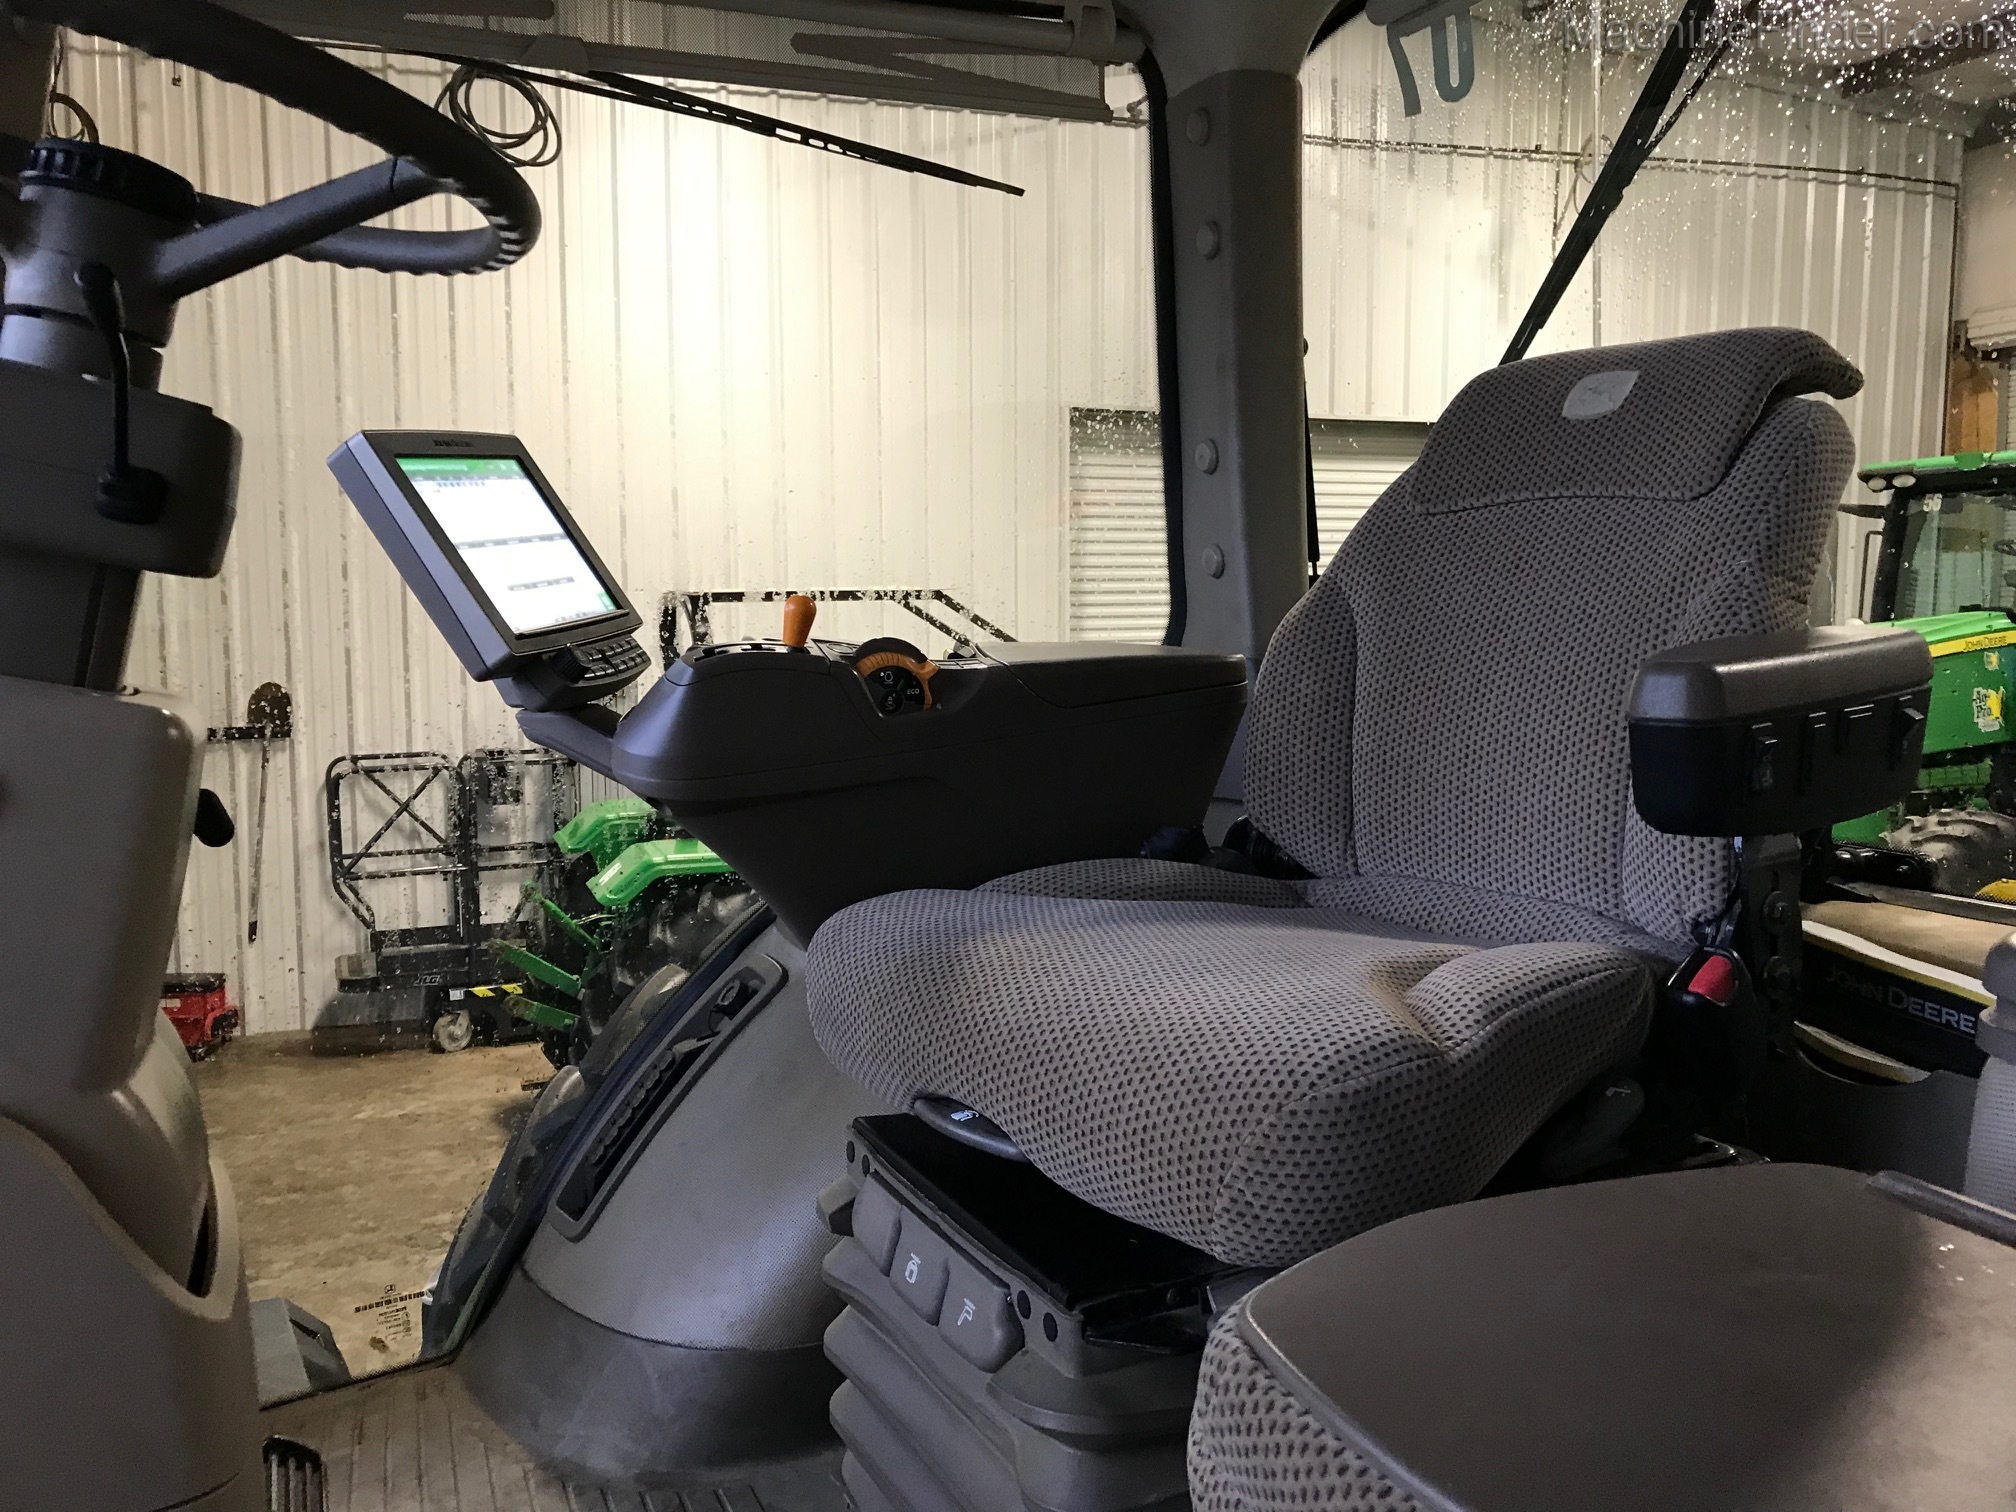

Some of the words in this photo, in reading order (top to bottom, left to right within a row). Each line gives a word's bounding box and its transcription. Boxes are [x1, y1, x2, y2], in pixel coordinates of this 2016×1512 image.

[1963, 639, 1984, 651] JOHN
[1984, 636, 2008, 647] DEERE
[906, 687, 919, 695] ECO
[413, 974, 440, 986] JLG
[1887, 984, 1976, 1035] DEERE
